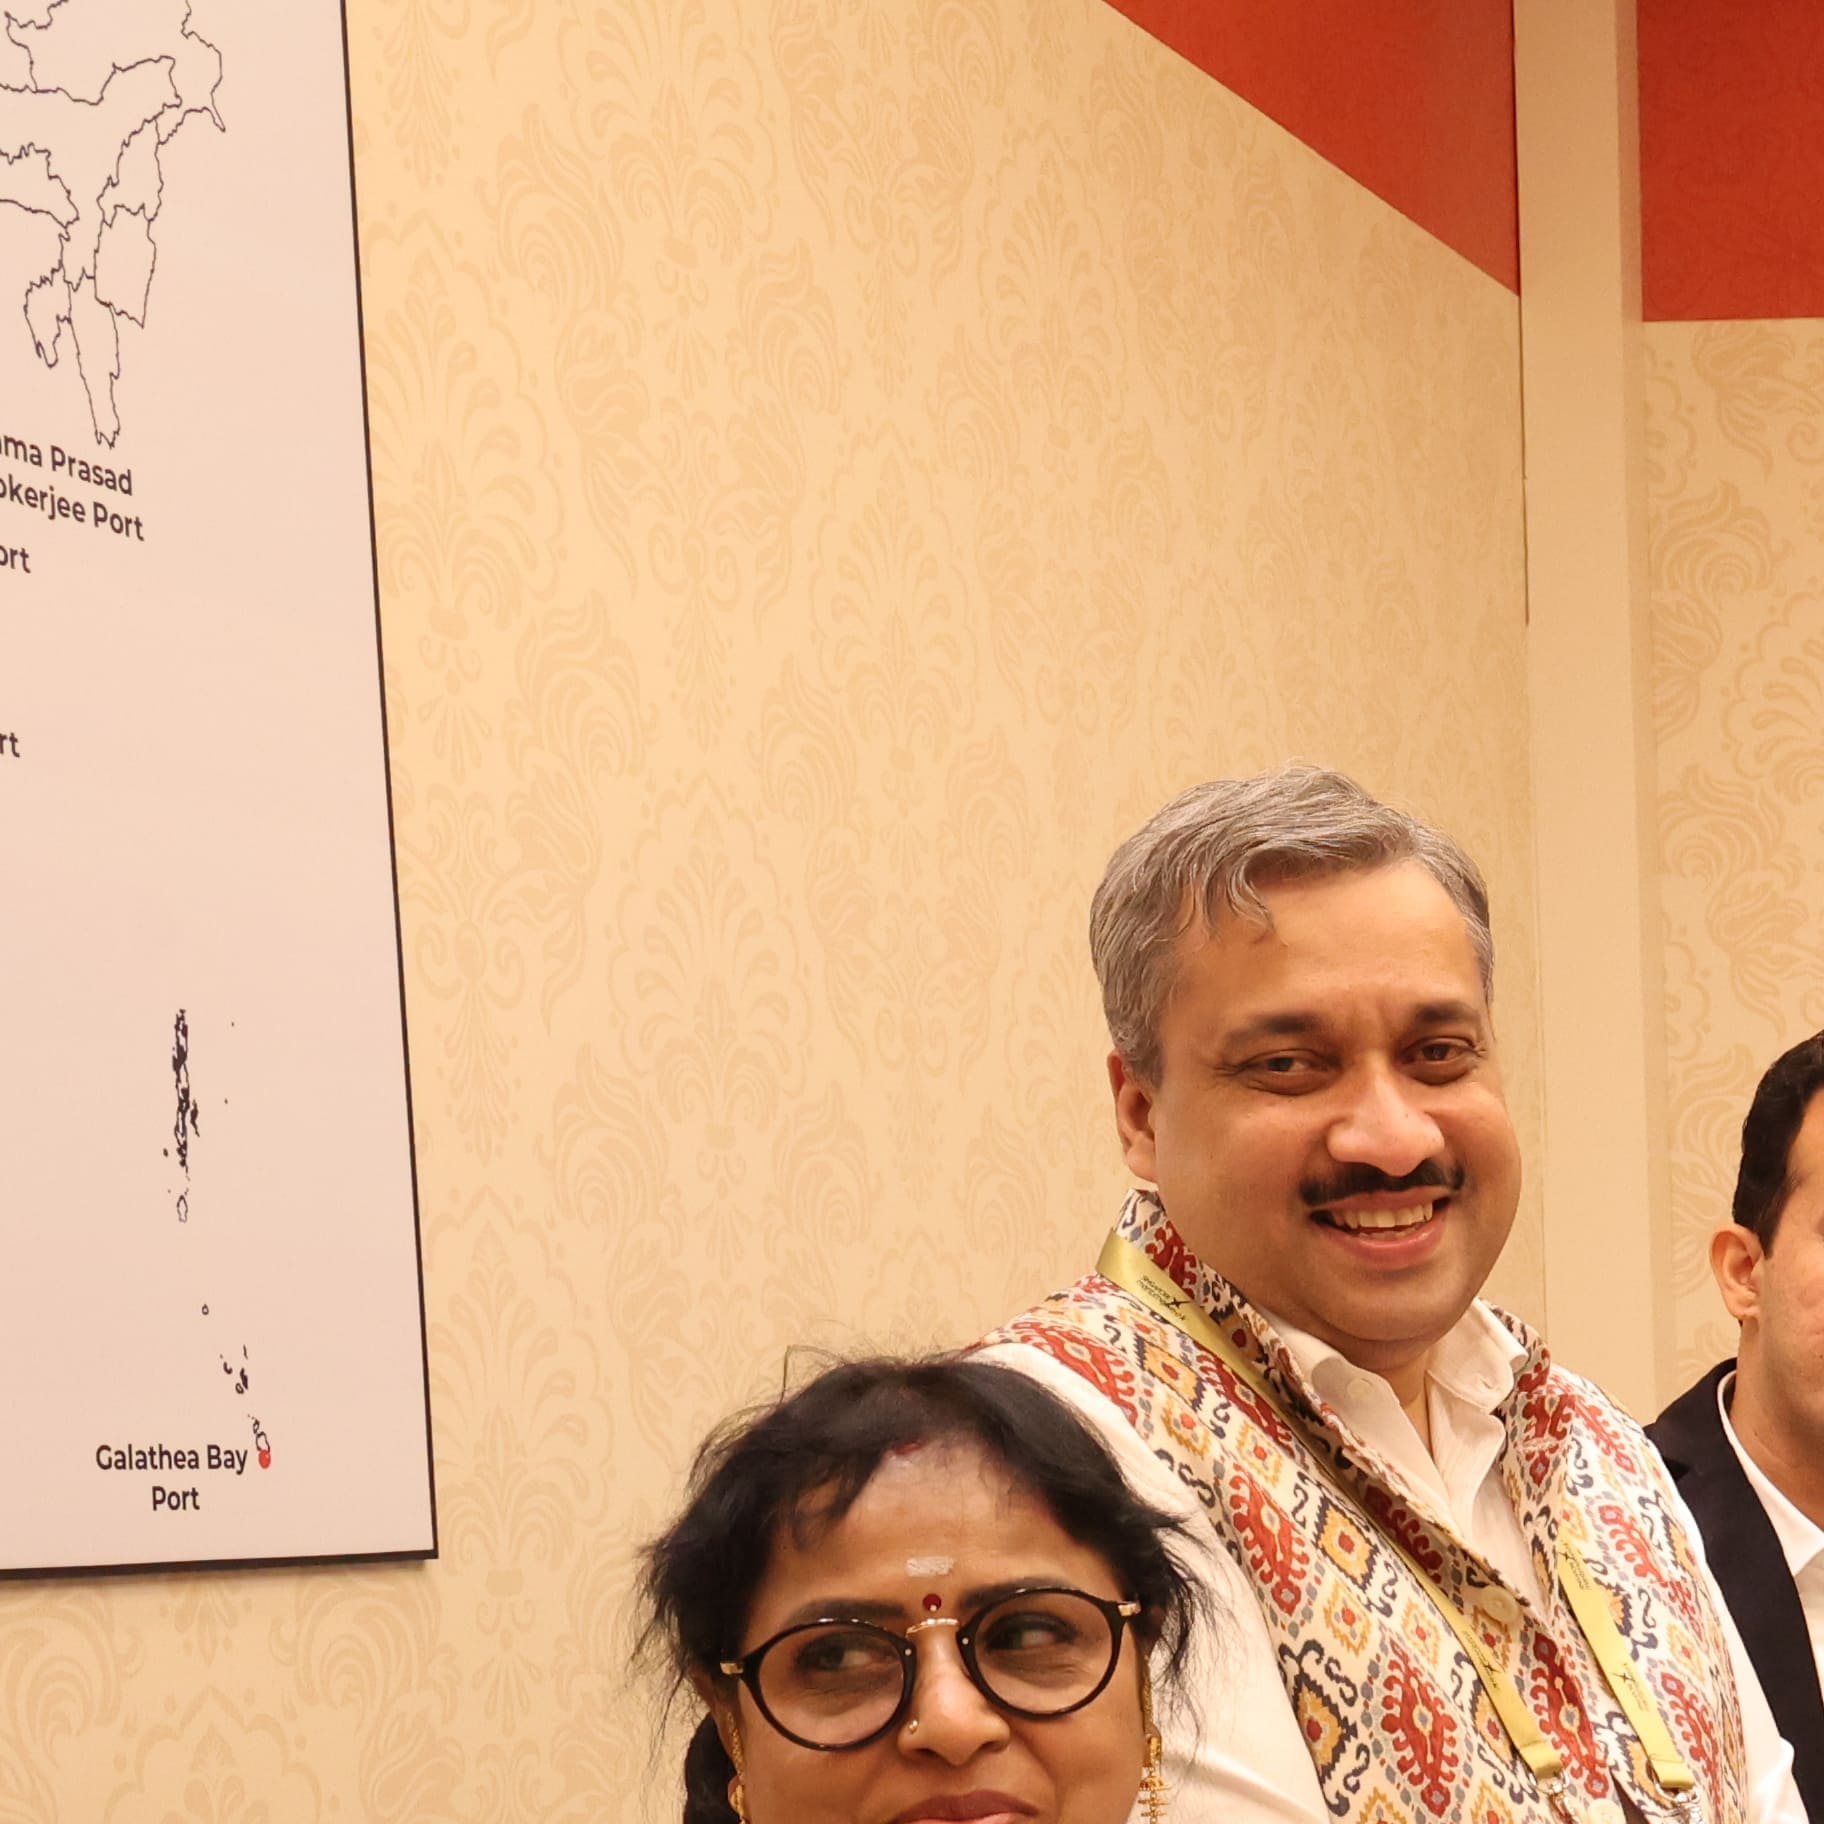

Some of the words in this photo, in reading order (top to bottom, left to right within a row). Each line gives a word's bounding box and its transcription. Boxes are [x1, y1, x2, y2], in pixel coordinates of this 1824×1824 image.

[0, 434, 42, 467] ma
[51, 445, 133, 496] Prasad
[93, 501, 144, 541] Port
[96, 1444, 200, 1470] Galathea
[207, 1444, 248, 1475] Bay
[152, 1486, 200, 1511] Port
